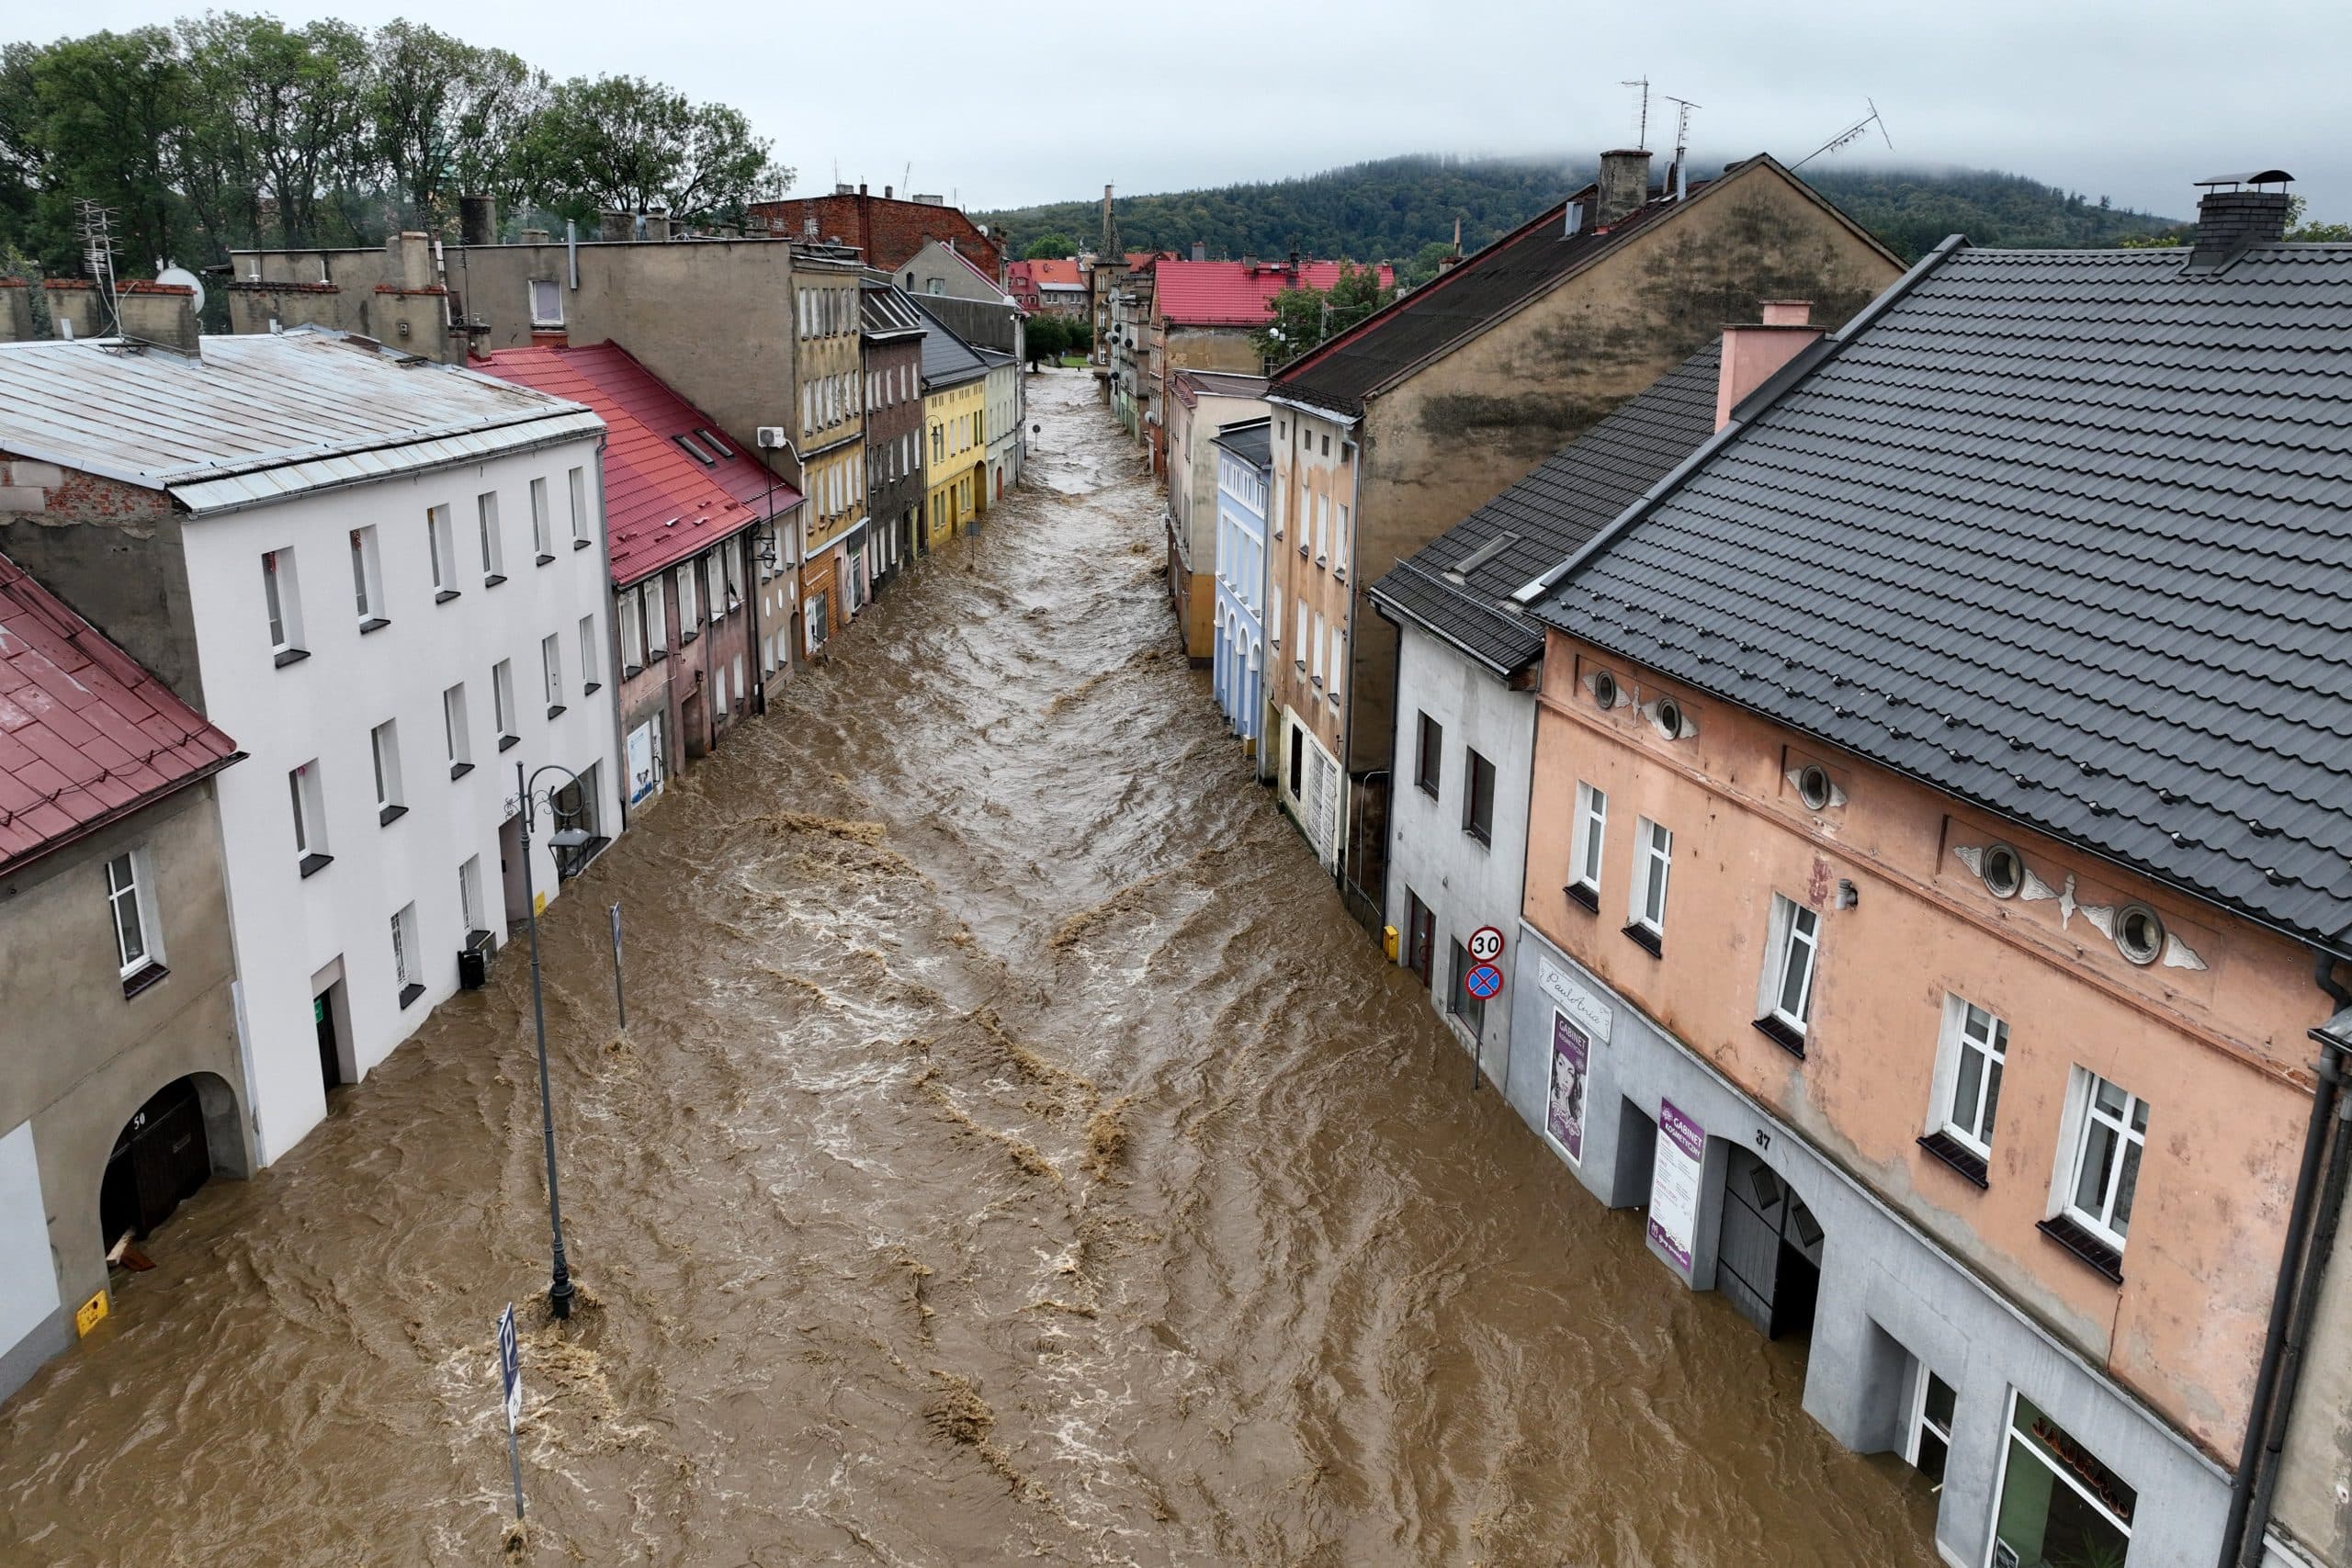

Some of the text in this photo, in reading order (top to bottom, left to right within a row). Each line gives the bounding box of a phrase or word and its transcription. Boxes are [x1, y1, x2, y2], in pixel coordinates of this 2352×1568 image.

[1474, 937, 1498, 953] 30
[1559, 1021, 1586, 1049] GABINET
[134, 1112, 145, 1130] 50
[1673, 1117, 1702, 1148] GABINET
[1665, 1122, 1701, 1157] KOSMETYCZNY
[1756, 1129, 1770, 1151] 37
[504, 1318, 513, 1374] P
